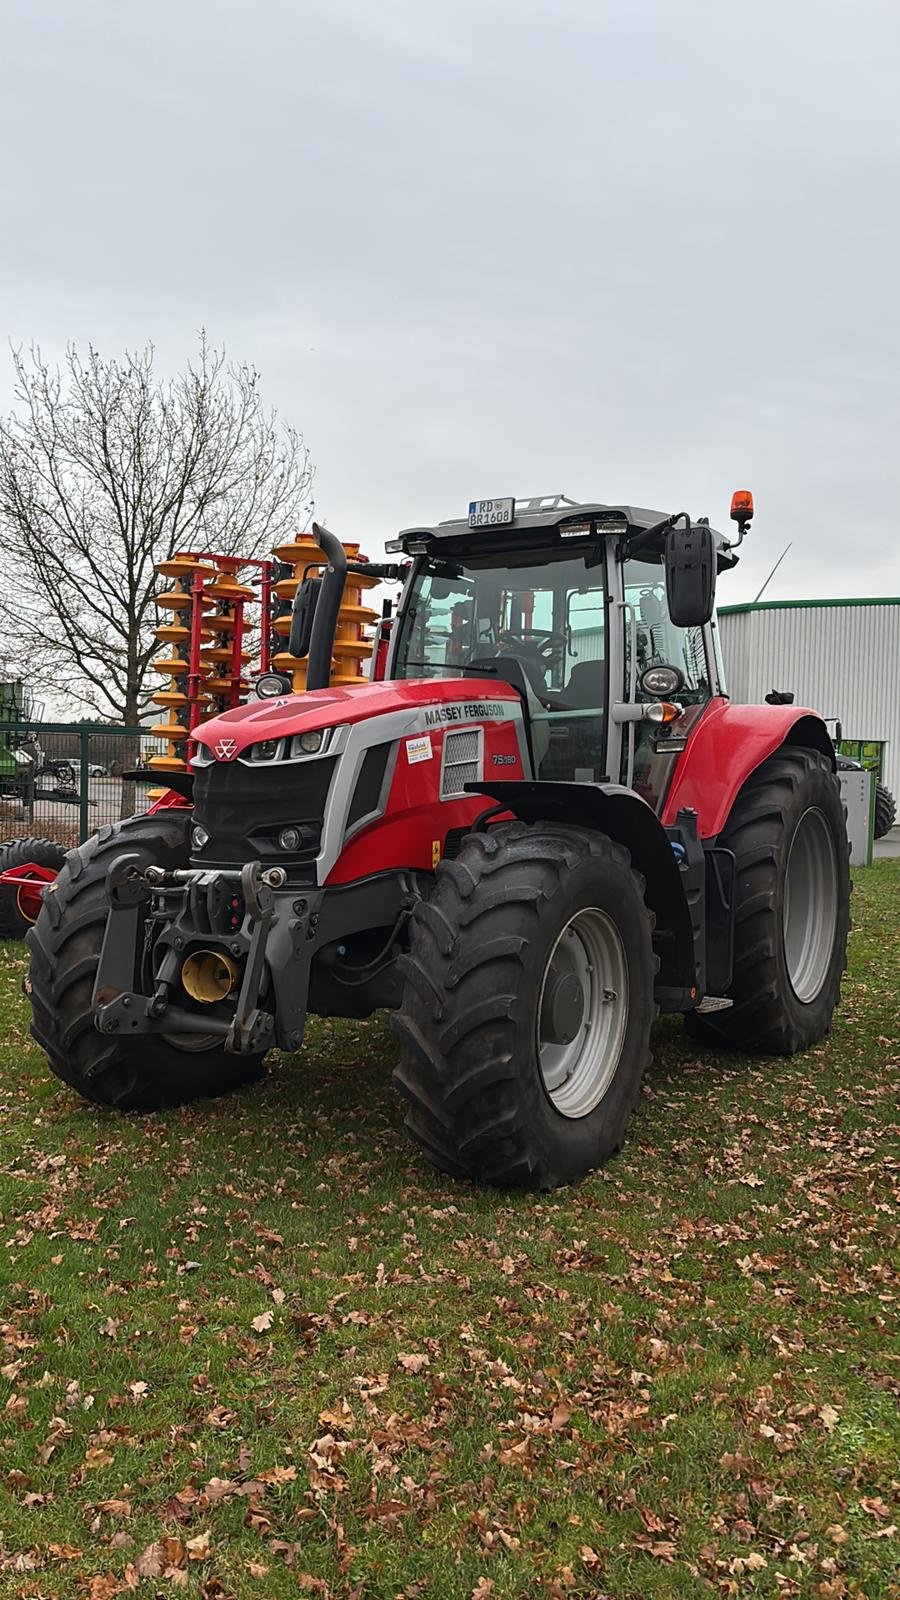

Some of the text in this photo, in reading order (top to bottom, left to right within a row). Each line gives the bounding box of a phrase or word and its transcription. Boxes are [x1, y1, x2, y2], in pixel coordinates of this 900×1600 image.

[479, 501, 493, 513] RD
[425, 704, 504, 725] MASSEY FERGUSON
